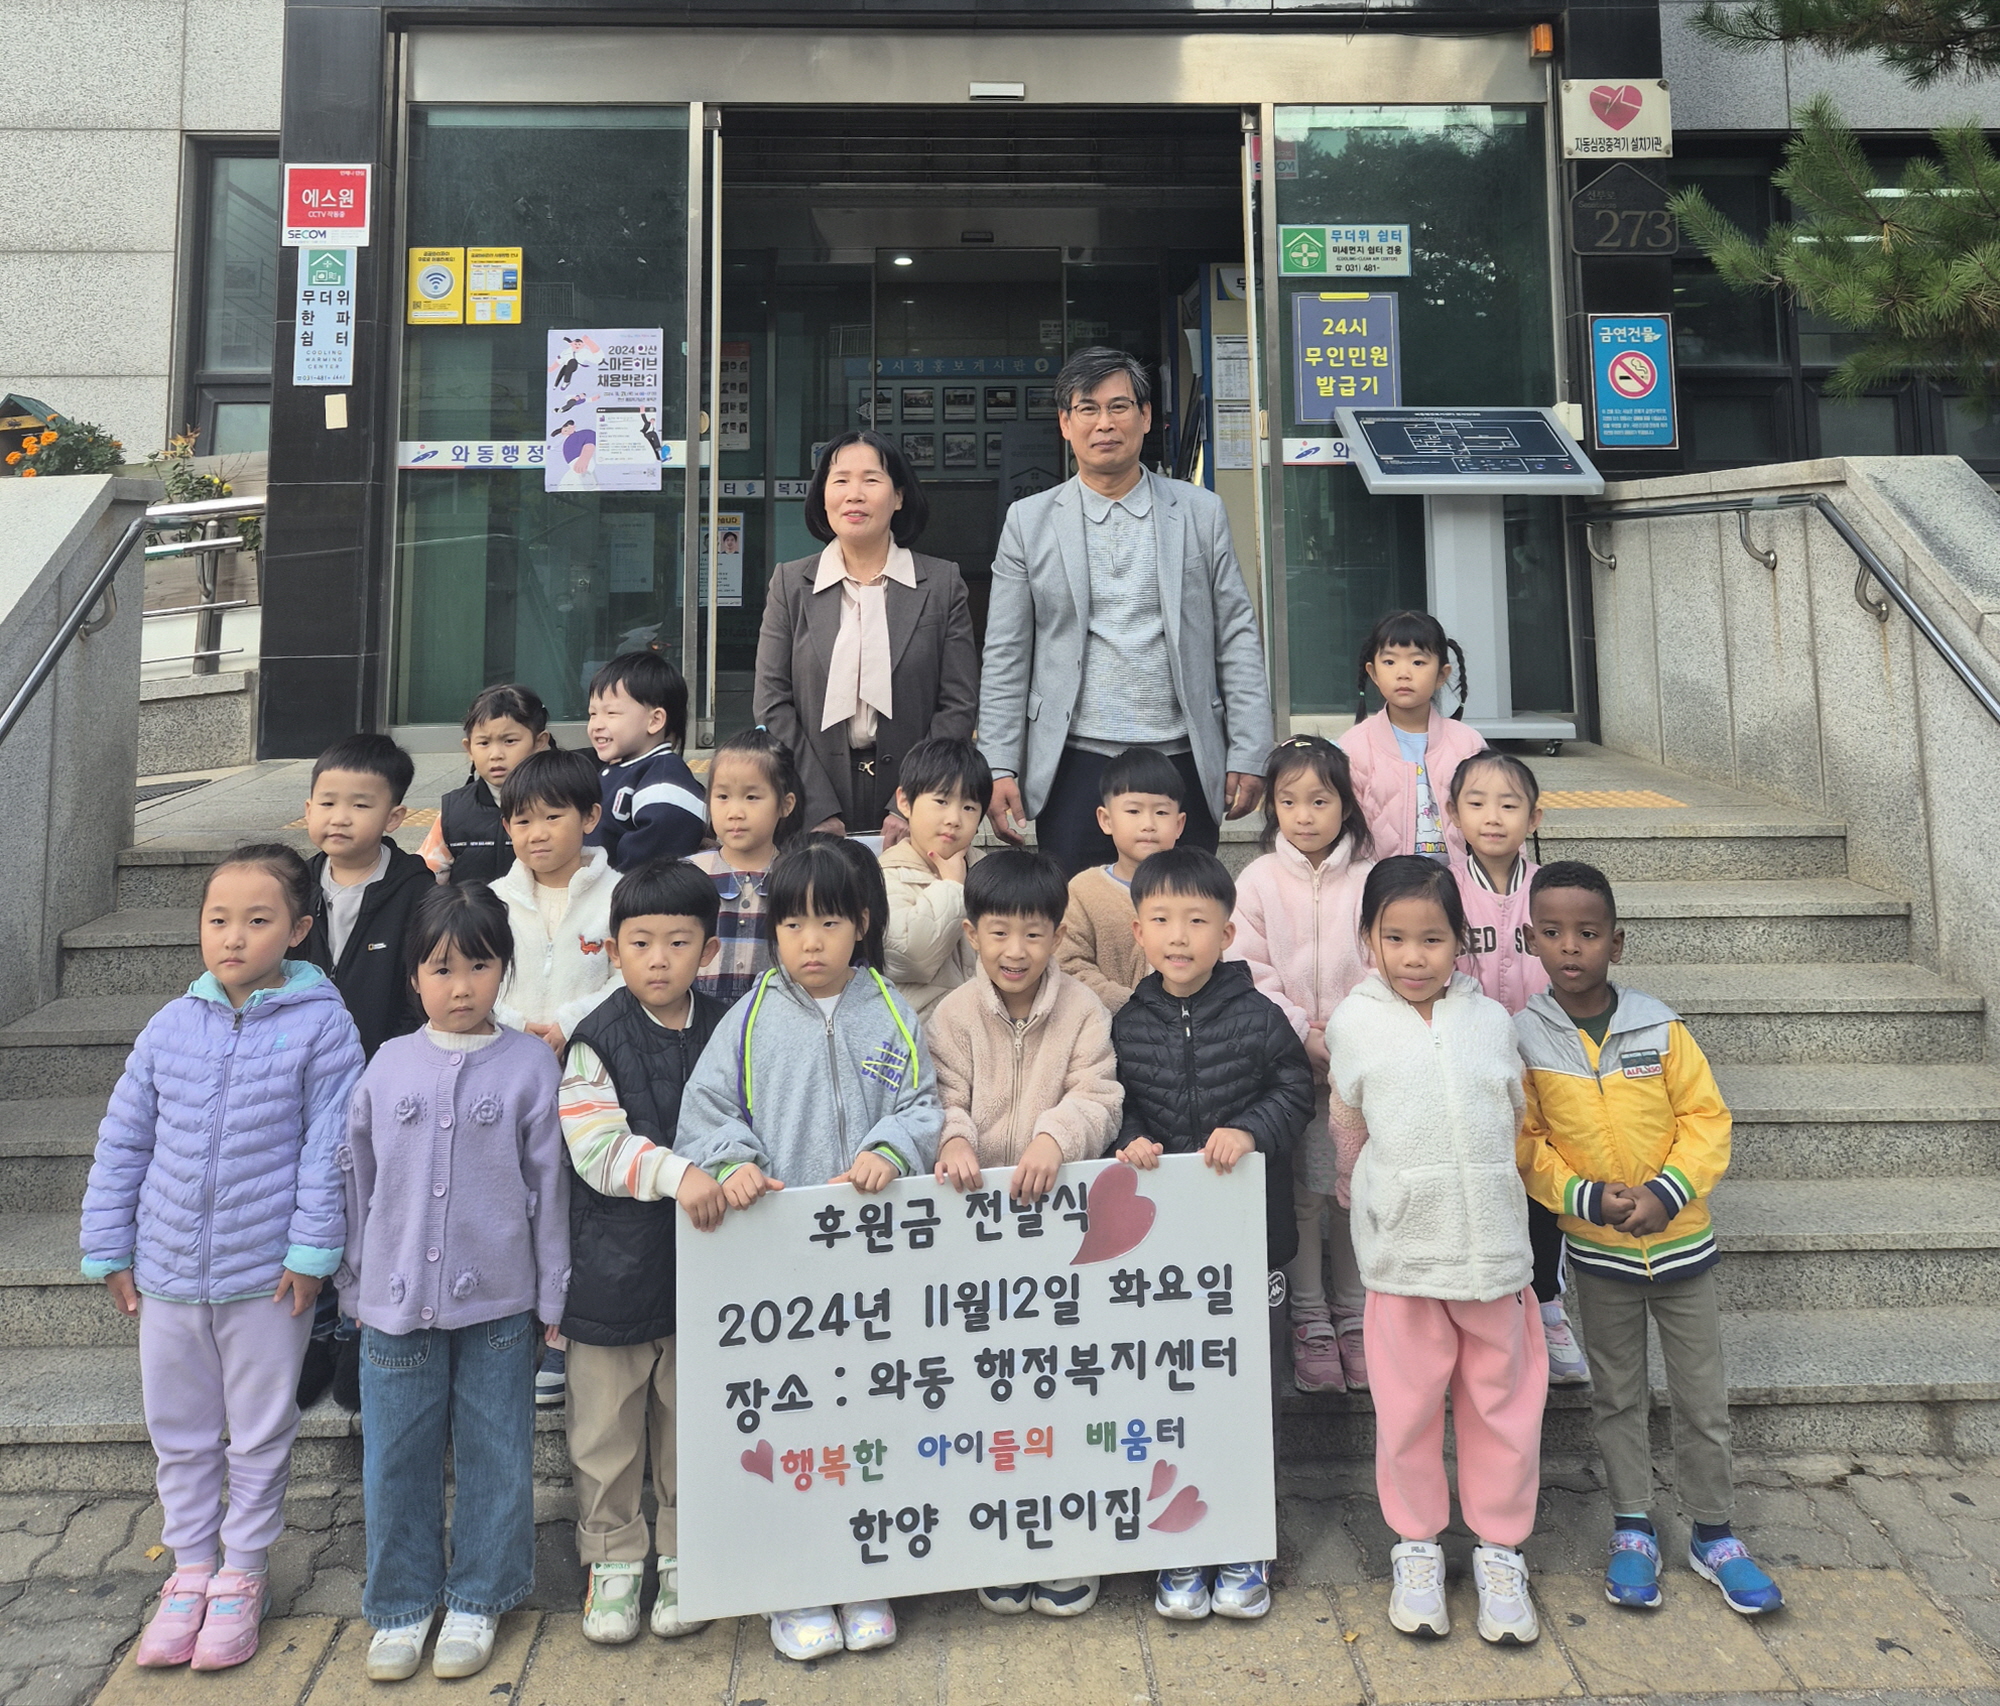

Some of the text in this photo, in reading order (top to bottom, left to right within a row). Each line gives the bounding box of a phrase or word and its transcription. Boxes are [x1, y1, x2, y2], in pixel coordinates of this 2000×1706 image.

[1575, 136, 1662, 152] 자동심장충격기 설치기관
[302, 188, 354, 208] 에스원
[288, 229, 327, 239] SECOM
[1331, 229, 1402, 243] 무더위 쉼터
[1595, 210, 1673, 248] 273
[1332, 246, 1364, 255] 미세먼지
[301, 290, 350, 306] 무더위
[1322, 317, 1367, 337] 24시
[1599, 326, 1656, 343] 금연건물
[608, 345, 635, 355] 2024
[1305, 346, 1389, 367] 무인민원
[1316, 375, 1379, 397] 발급기
[809, 1198, 942, 1254] 후원금
[718, 1287, 892, 1348] 2024년
[1108, 1264, 1234, 1316] 화요일
[725, 1373, 814, 1434] 장소
[868, 1356, 955, 1410] 와동
[973, 1336, 1237, 1403] 행정복지센터
[781, 1416, 1185, 1491] 행복한 아이들의 배움터
[849, 1486, 1141, 1565] 한양 어린이집
